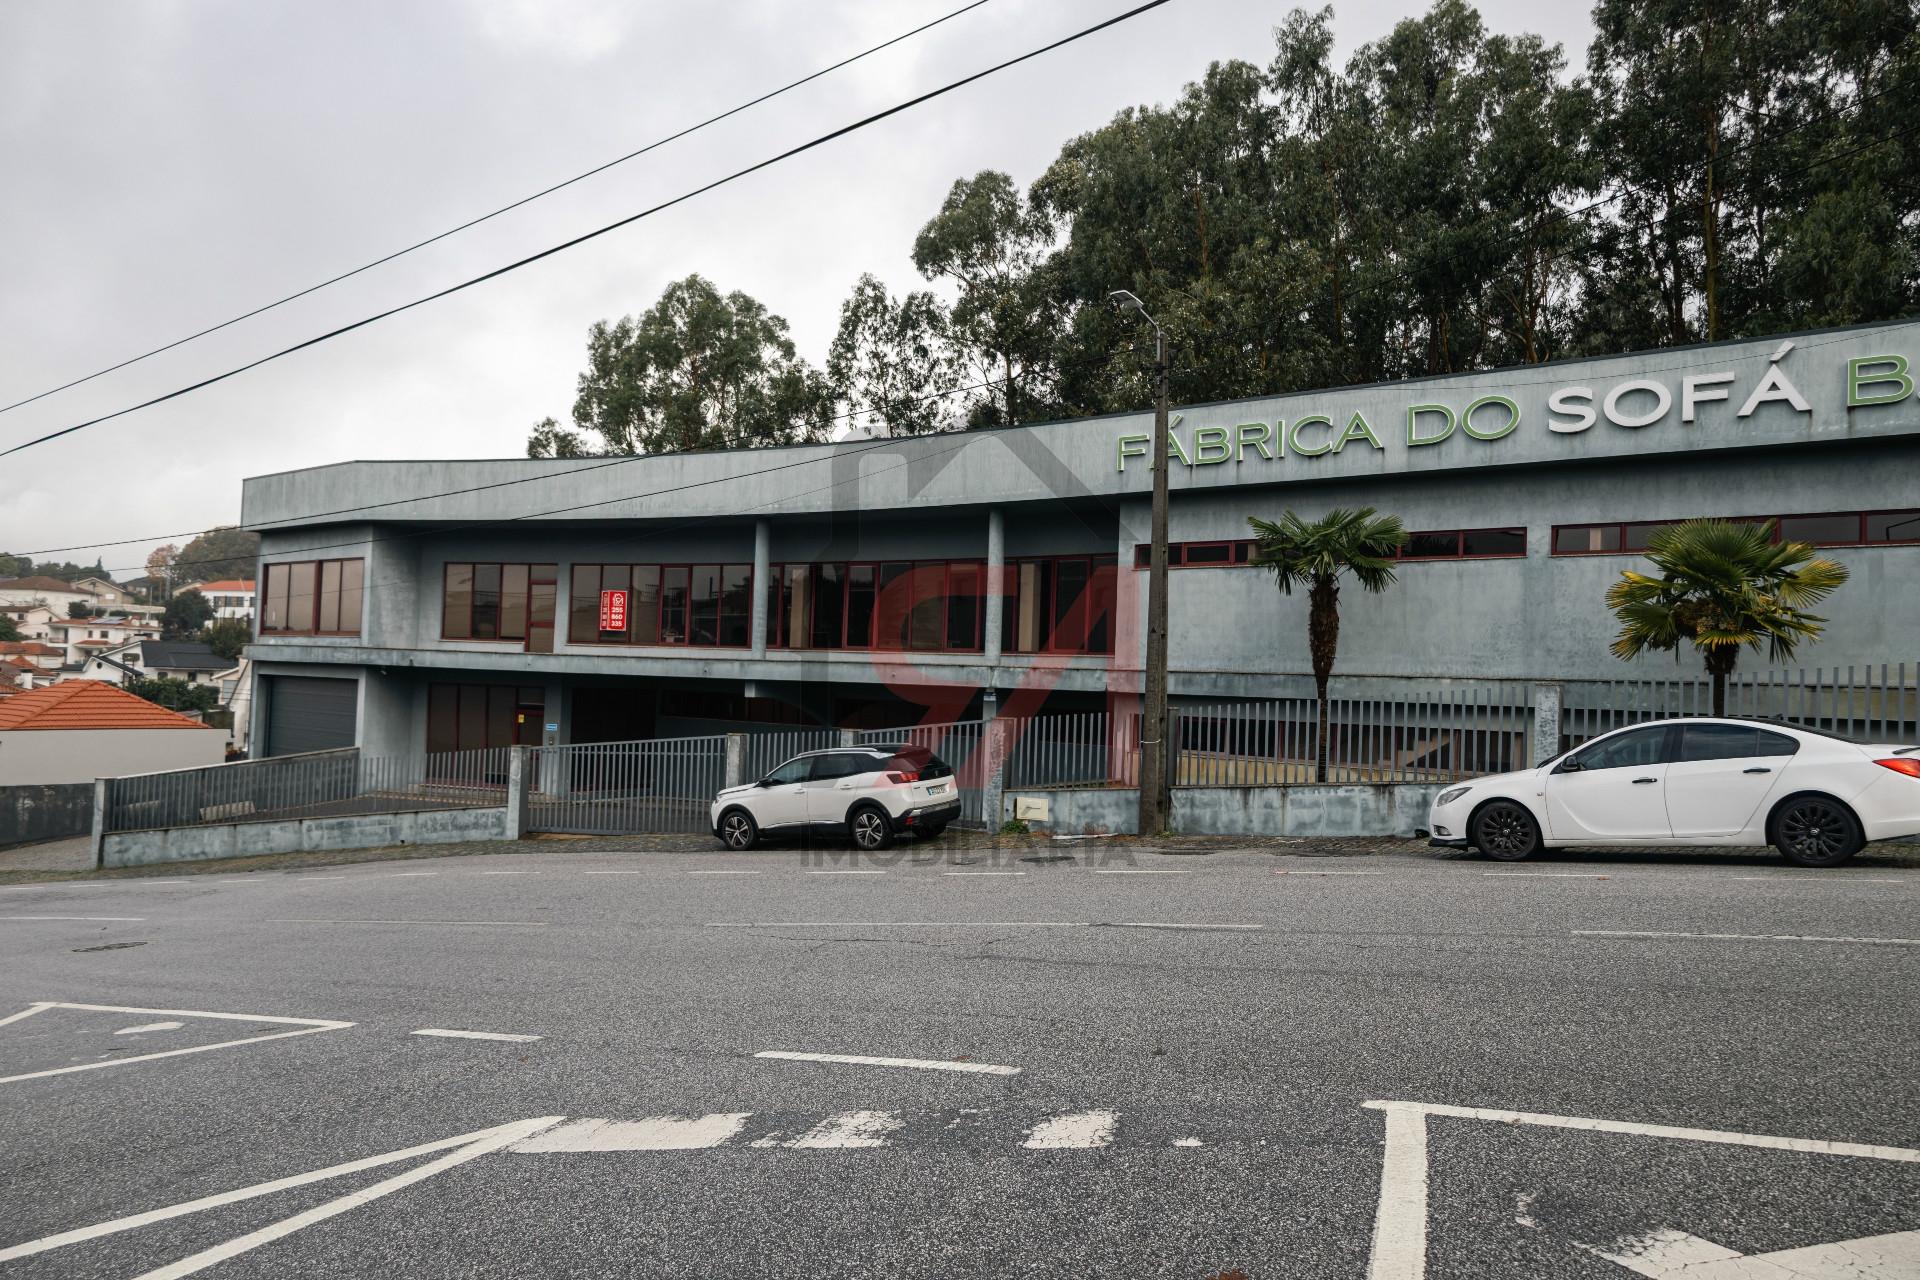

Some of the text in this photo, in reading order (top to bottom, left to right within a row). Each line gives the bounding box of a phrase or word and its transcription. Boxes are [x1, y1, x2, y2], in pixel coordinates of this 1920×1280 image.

[1116, 340, 1920, 471] FÁBRICA DO SOFÁ B
